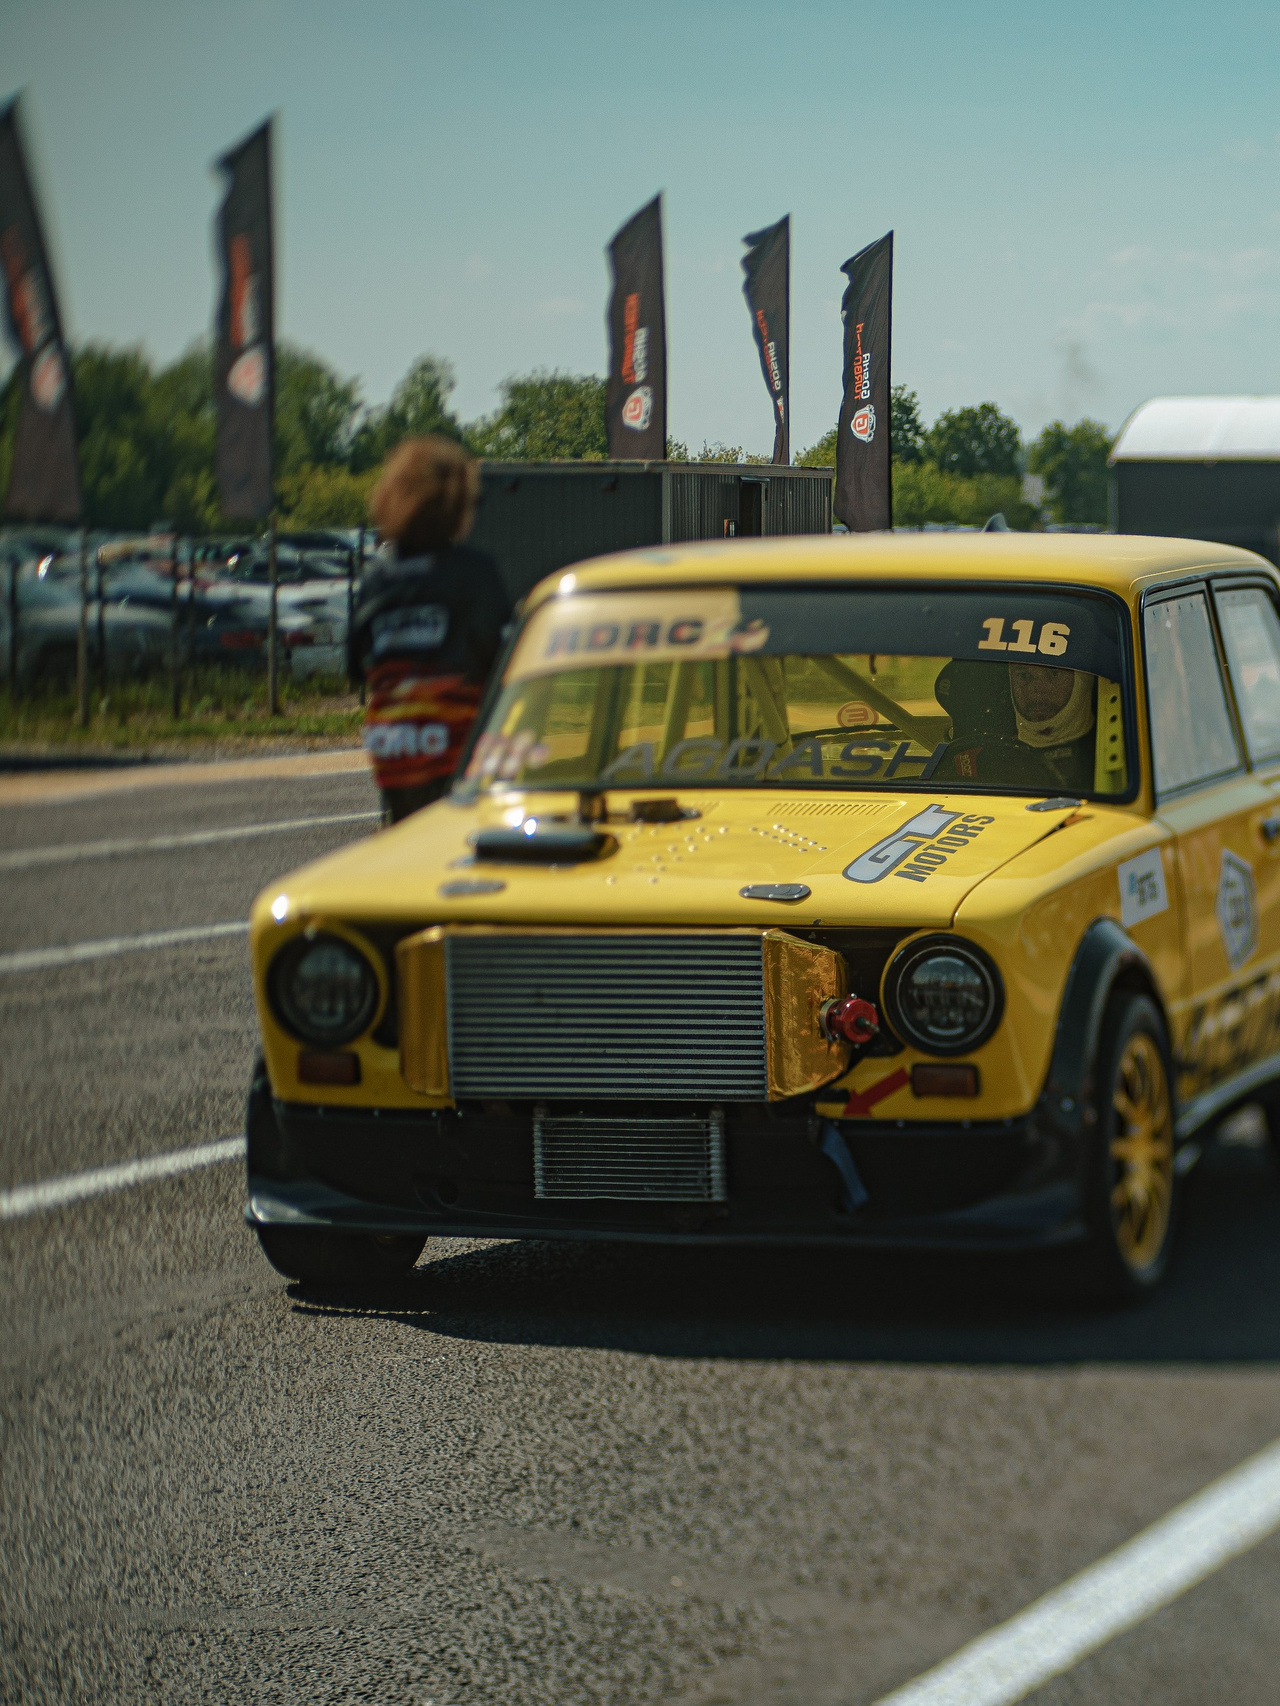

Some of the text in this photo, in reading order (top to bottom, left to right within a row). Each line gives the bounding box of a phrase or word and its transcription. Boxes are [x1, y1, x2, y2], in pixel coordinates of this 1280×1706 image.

[978, 617, 1070, 656] 116
[601, 738, 949, 781] AGDASH
[894, 814, 995, 883] MOTORS
